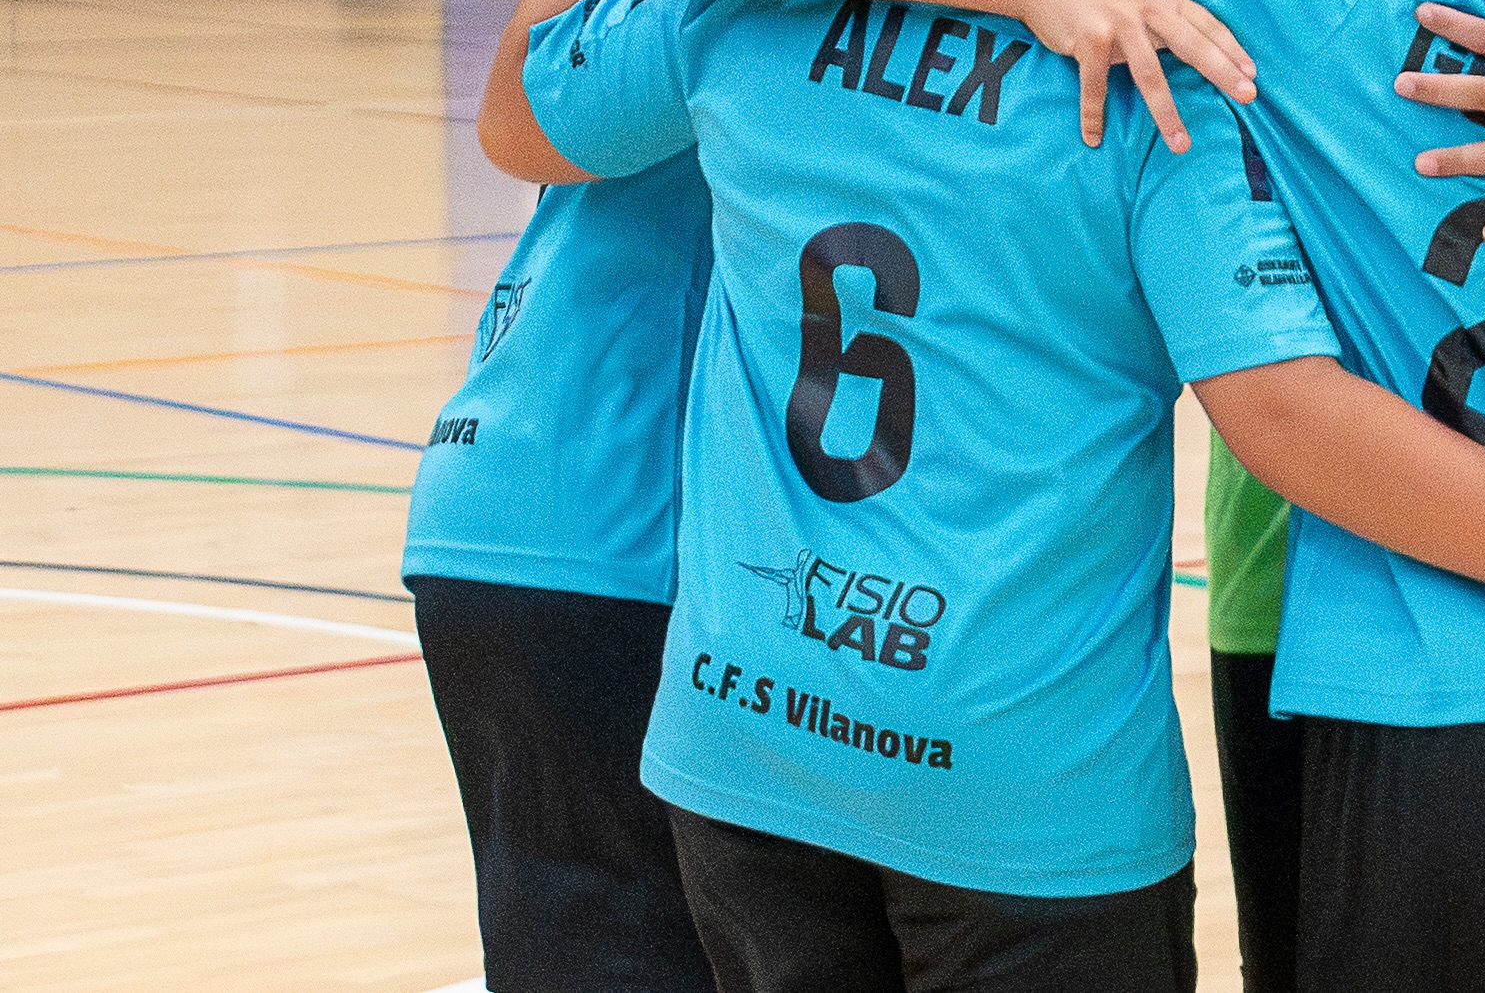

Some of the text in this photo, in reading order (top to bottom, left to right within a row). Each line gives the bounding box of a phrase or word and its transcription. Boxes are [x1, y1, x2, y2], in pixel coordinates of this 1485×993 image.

[785, 221, 920, 504] 6
[800, 594, 930, 672] LAB
[804, 557, 946, 628] FISIO
[692, 653, 953, 770] C.F.S Vilanova
